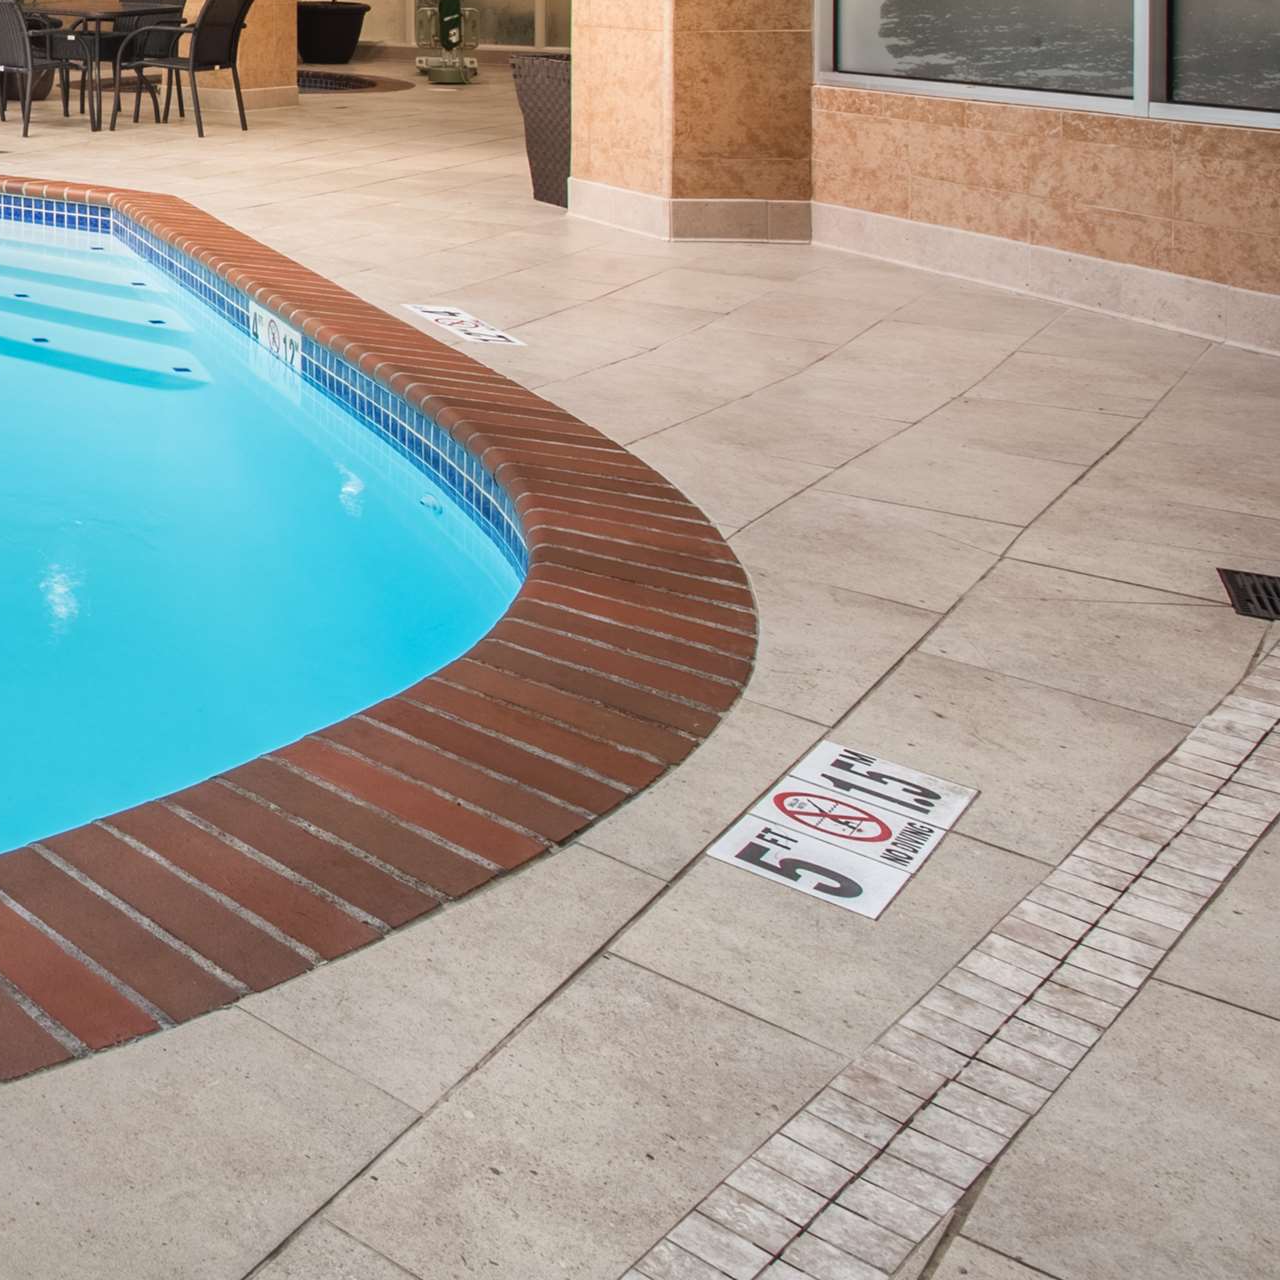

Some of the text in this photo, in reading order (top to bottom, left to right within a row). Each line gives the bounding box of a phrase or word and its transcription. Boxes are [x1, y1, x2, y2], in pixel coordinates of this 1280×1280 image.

[838, 748, 877, 767] M
[734, 826, 863, 899] 5 FT
[880, 821, 935, 867] NO DIVING
